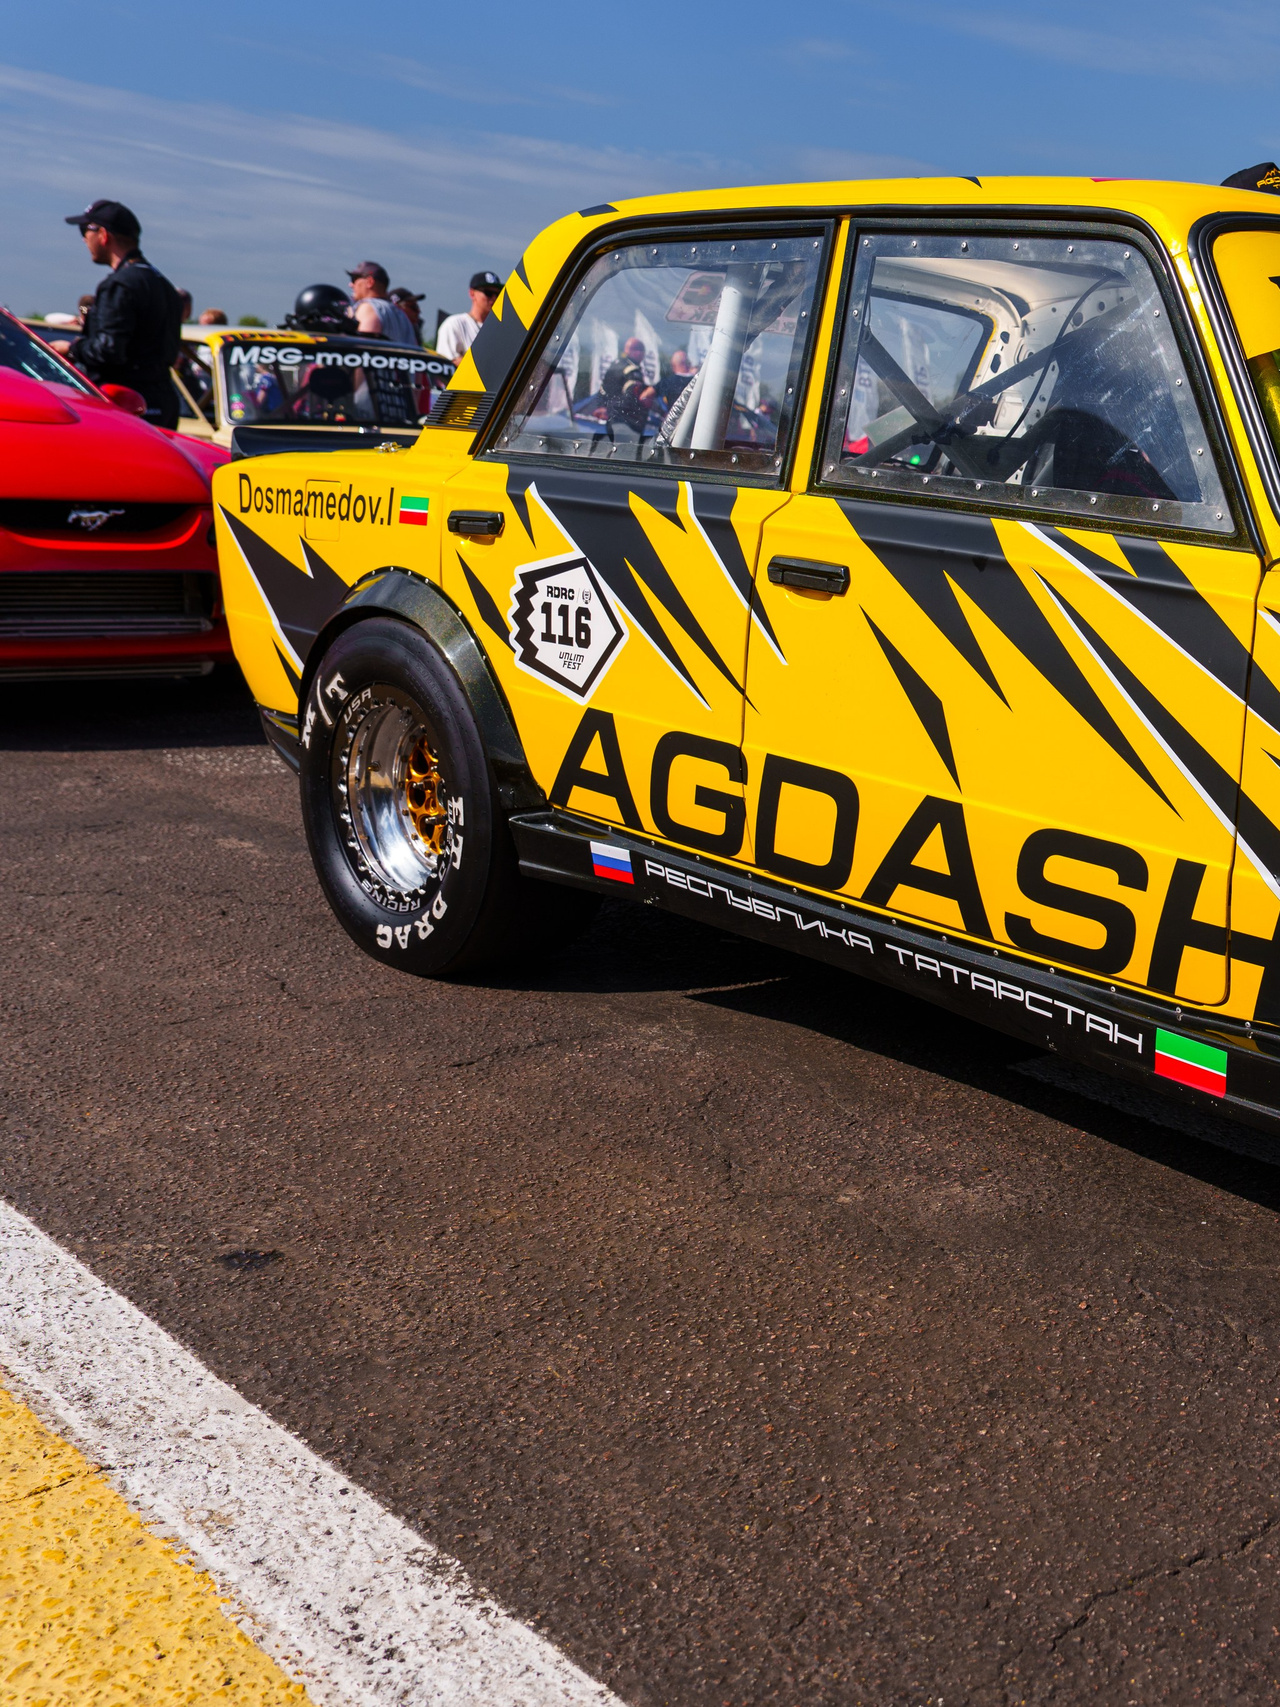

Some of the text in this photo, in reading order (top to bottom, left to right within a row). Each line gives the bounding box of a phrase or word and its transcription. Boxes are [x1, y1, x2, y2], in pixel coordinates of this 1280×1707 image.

[229, 345, 457, 376] MSG-motorspor
[546, 585, 575, 600] RDRC
[541, 601, 591, 649] 116
[562, 660, 582, 670] FEST
[302, 672, 349, 749] M/T
[344, 687, 372, 724] USA
[361, 880, 421, 912] RACING
[376, 890, 448, 949] DRAG
[645, 859, 1143, 1054] РЕСПУБЛИКА ТАТАРСТАН
